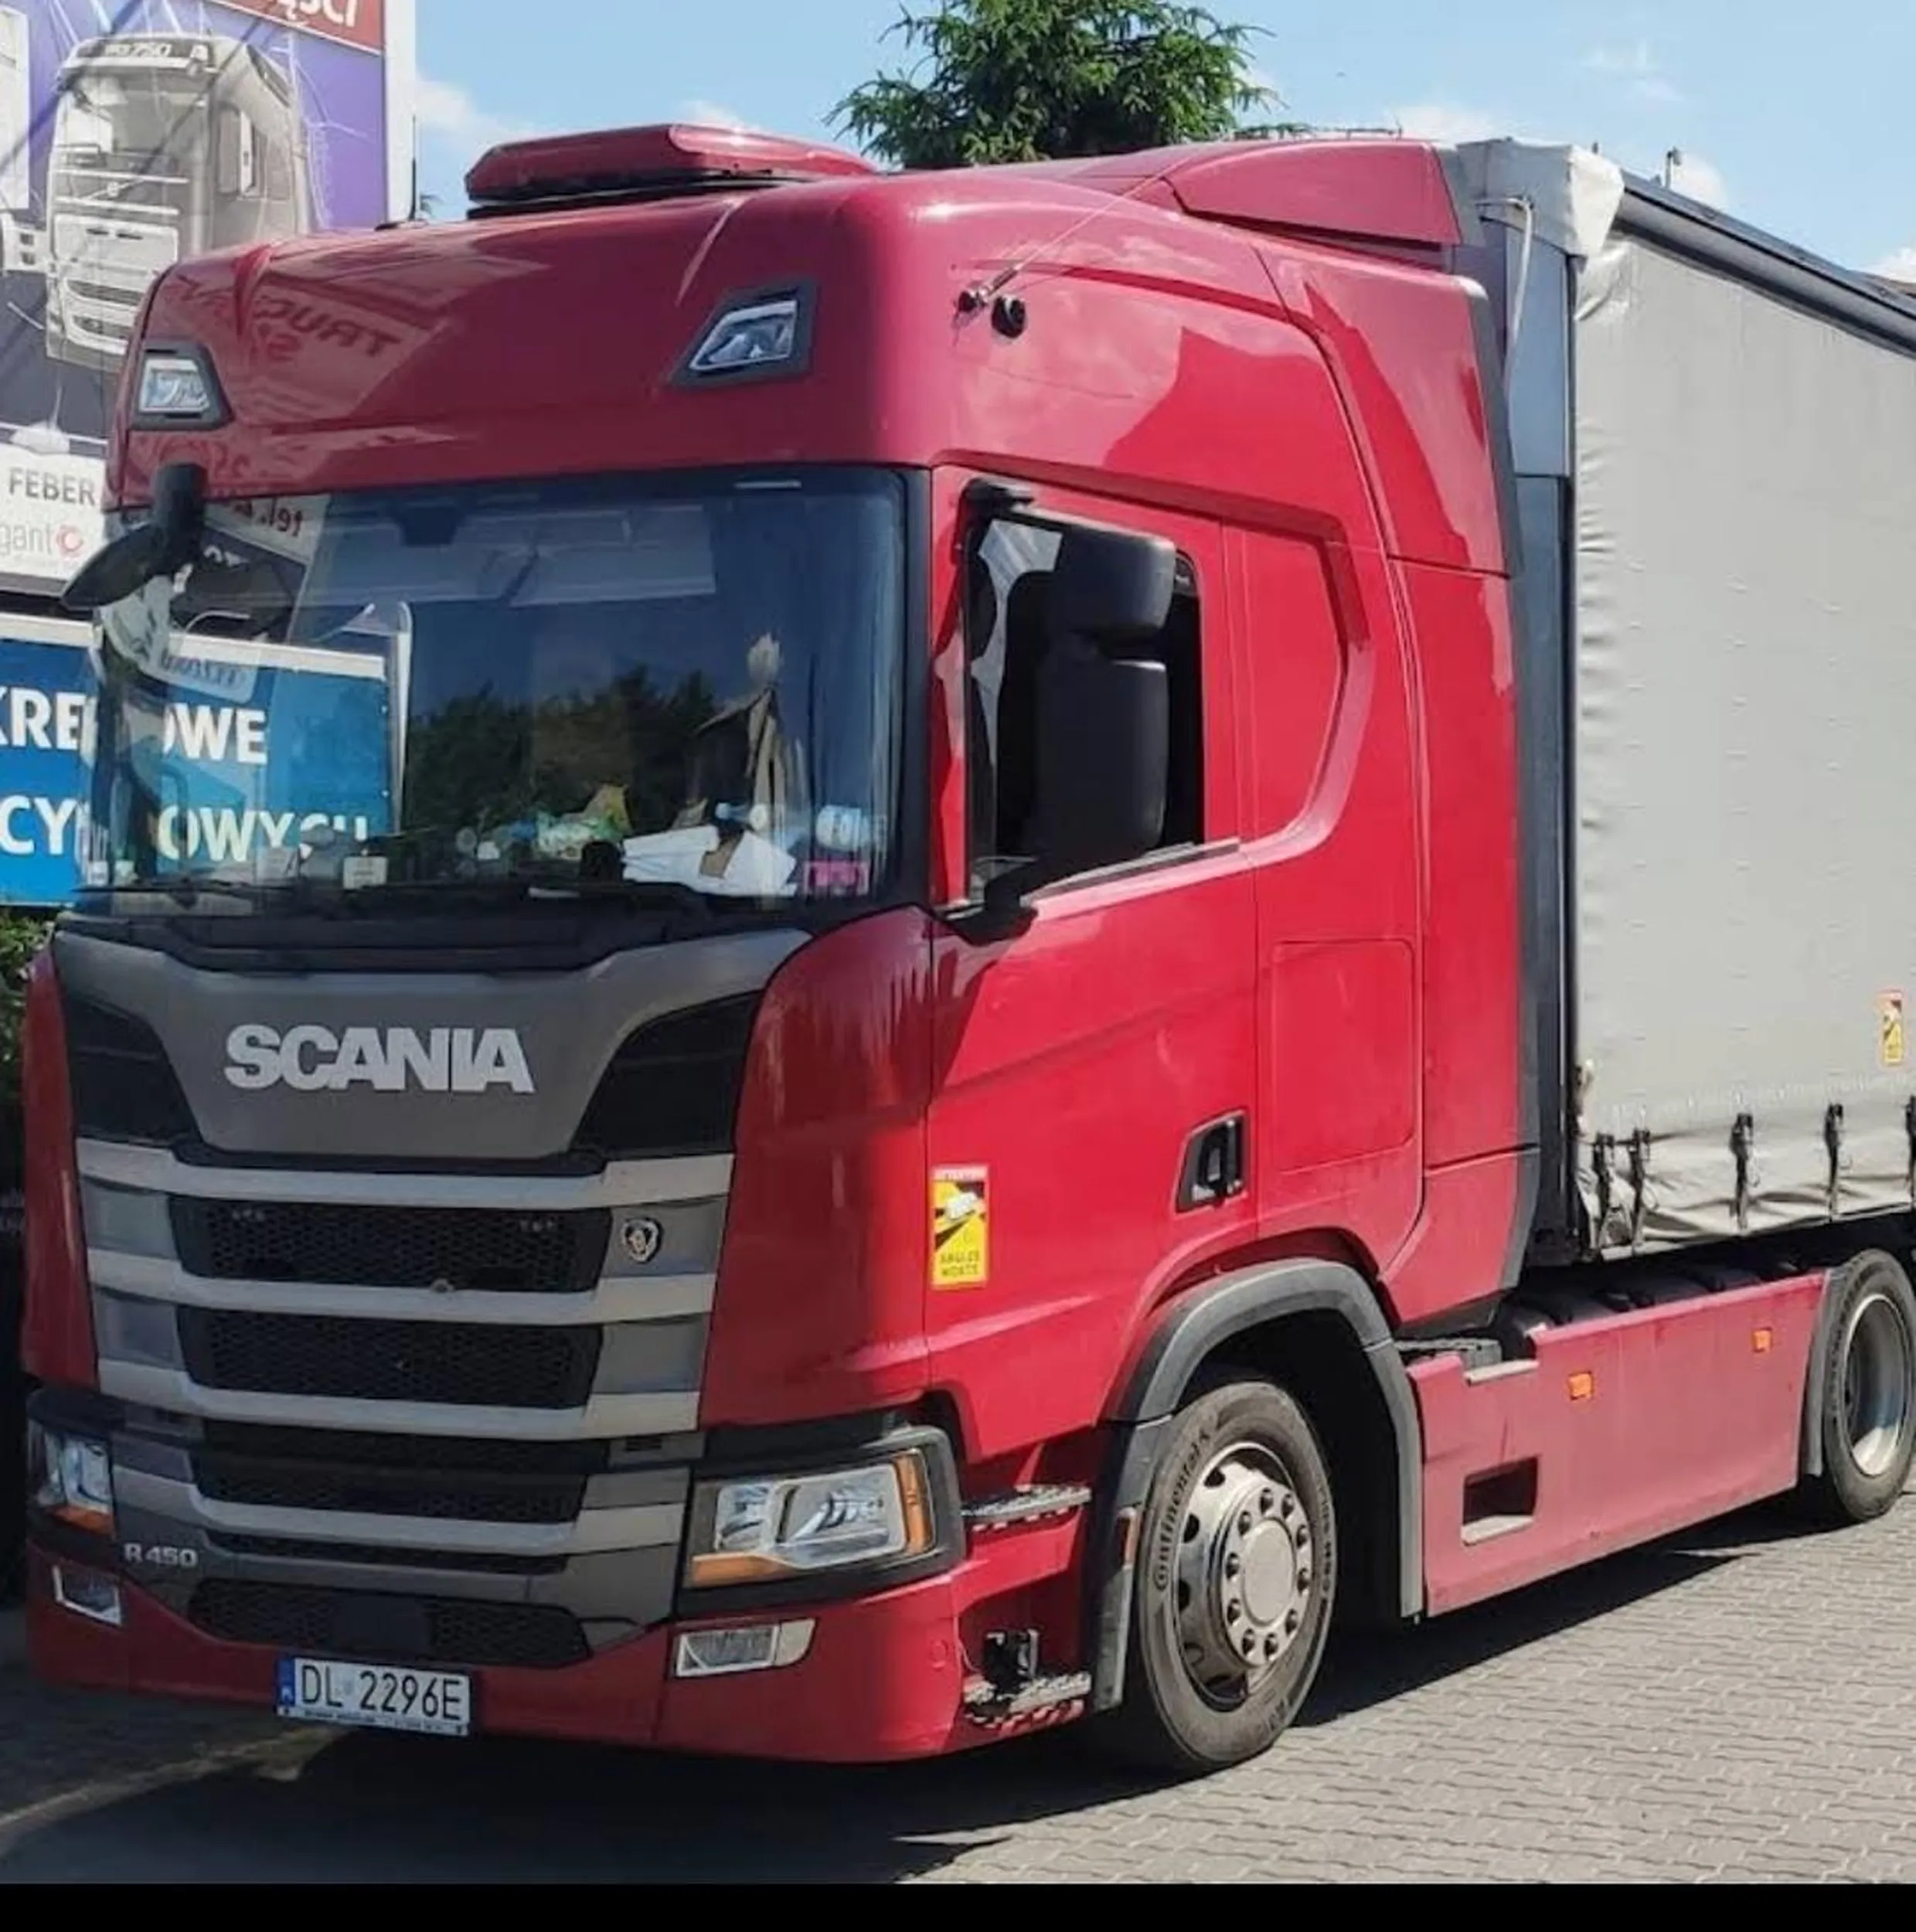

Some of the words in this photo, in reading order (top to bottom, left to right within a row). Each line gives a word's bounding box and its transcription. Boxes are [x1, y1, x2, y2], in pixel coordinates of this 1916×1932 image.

[9, 467, 96, 506] FEBER
[223, 1023, 536, 1094] SCANIA
[124, 1542, 144, 1563] R
[145, 1546, 199, 1568] 450
[301, 1664, 343, 1709] DL
[359, 1670, 461, 1721] 2296E
